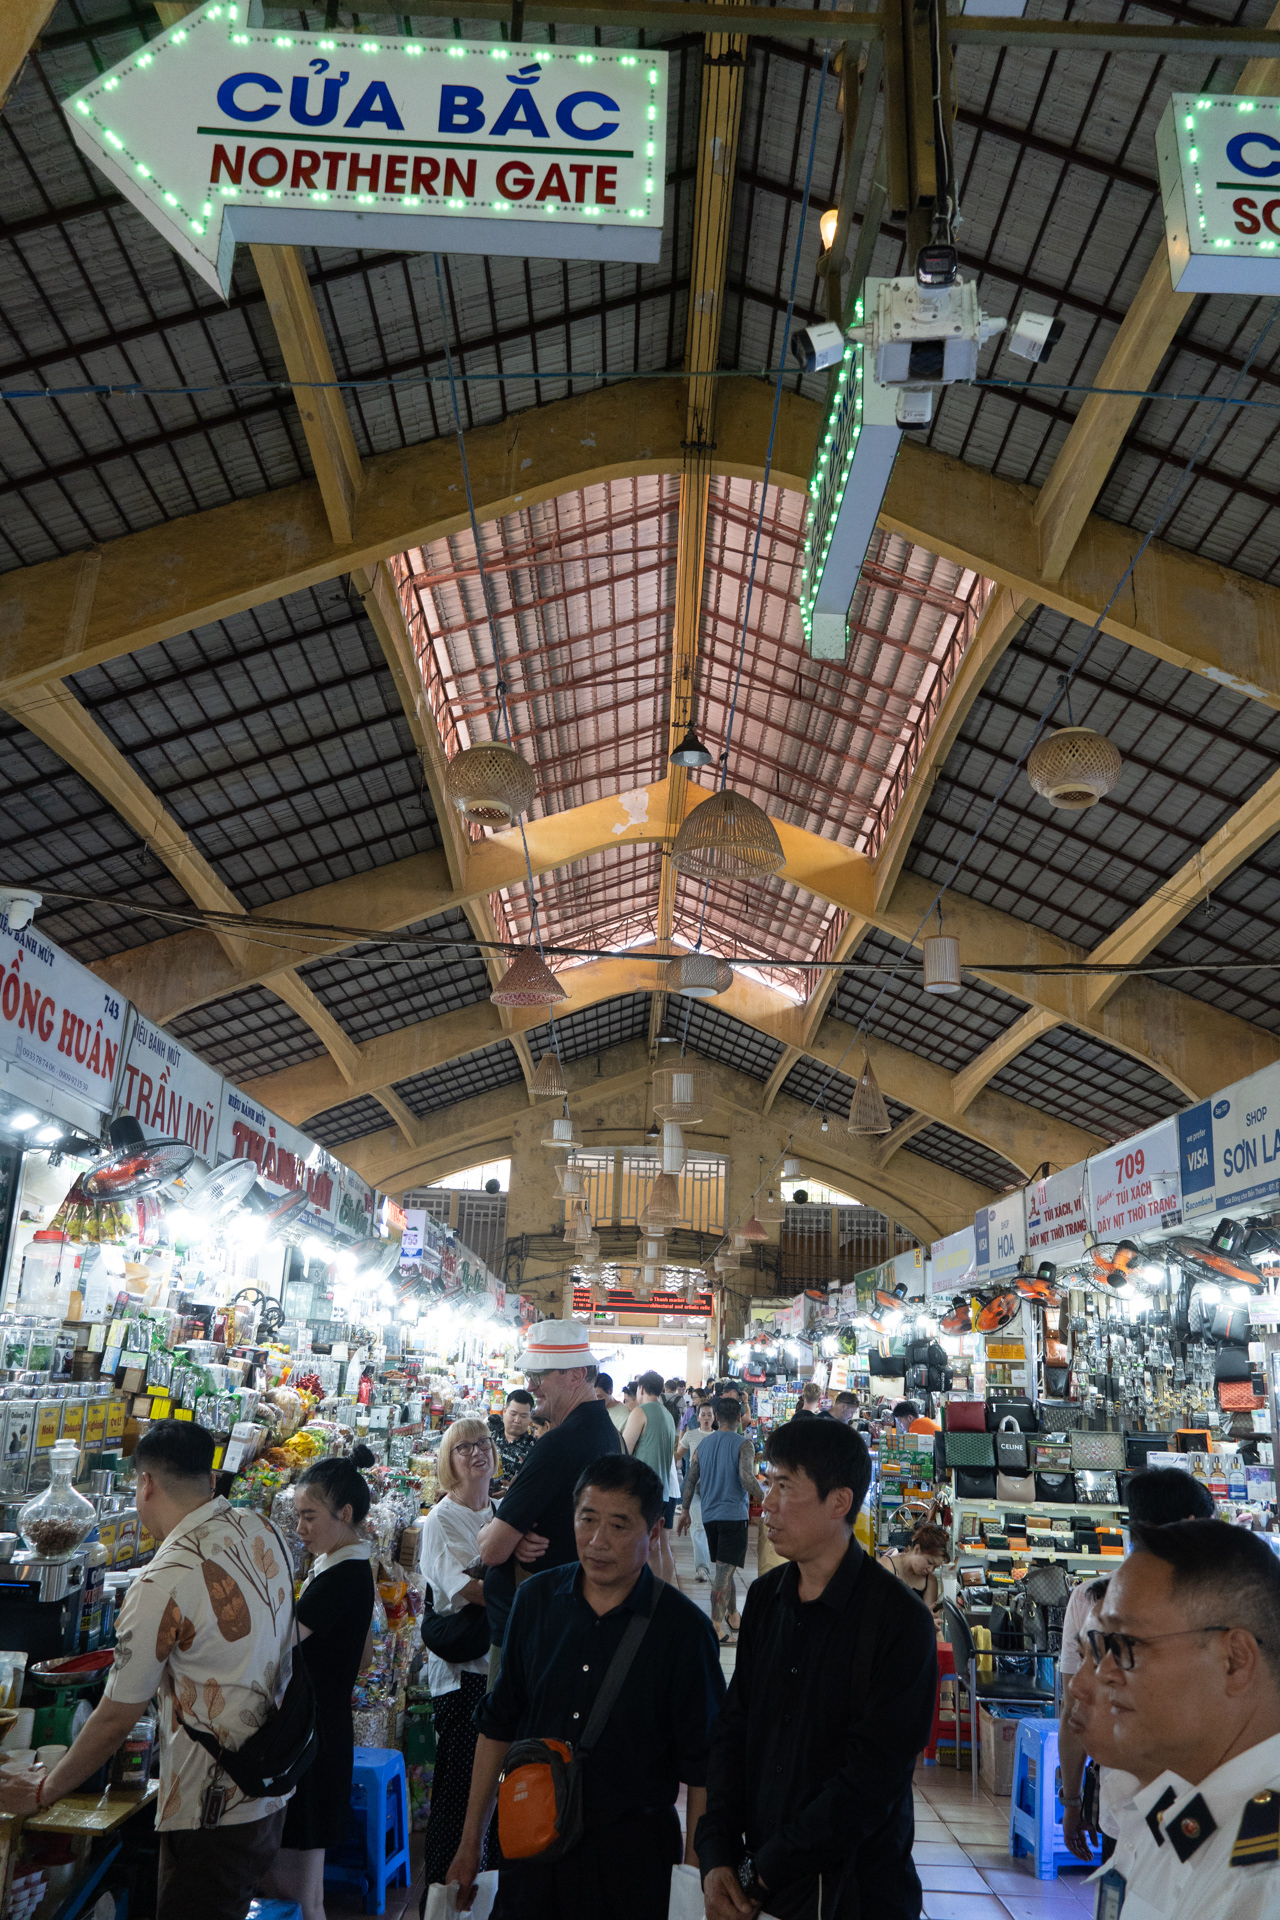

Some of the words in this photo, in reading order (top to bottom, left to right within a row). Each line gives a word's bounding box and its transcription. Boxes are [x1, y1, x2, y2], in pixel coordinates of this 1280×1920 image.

[217, 58, 405, 130] CỬA
[438, 62, 622, 141] BẮC
[209, 144, 478, 198] NORTHERN
[495, 159, 618, 205] GATE
[0, 949, 56, 1043] ỒNG
[57, 1009, 118, 1083] HUÂN
[104, 994, 119, 1020] 743
[148, 1031, 167, 1060] BÁNH
[126, 1063, 183, 1139] TRẦN
[184, 1101, 214, 1155] MỸ
[1246, 1106, 1267, 1127] SHOP
[1115, 1148, 1145, 1185] 709
[1187, 1147, 1209, 1172] VISA
[1223, 1138, 1258, 1178] SƠN
[1115, 1186, 1131, 1206] TÚI
[1131, 1180, 1152, 1201] XÁCH
[1185, 1193, 1214, 1213] Sacombank
[1043, 1205, 1054, 1222] TÚI
[1074, 1194, 1082, 1212] VÍ
[1097, 1215, 1112, 1234] DÂY
[1113, 1211, 1125, 1231] NỊT
[1127, 1202, 1147, 1224] THỜI
[1148, 1194, 1177, 1217] TRANG
[998, 1233, 1015, 1259] HOA
[1029, 1233, 1040, 1248] DÂY
[1040, 1229, 1050, 1246] NỊT
[1064, 1218, 1087, 1237] TRANG
